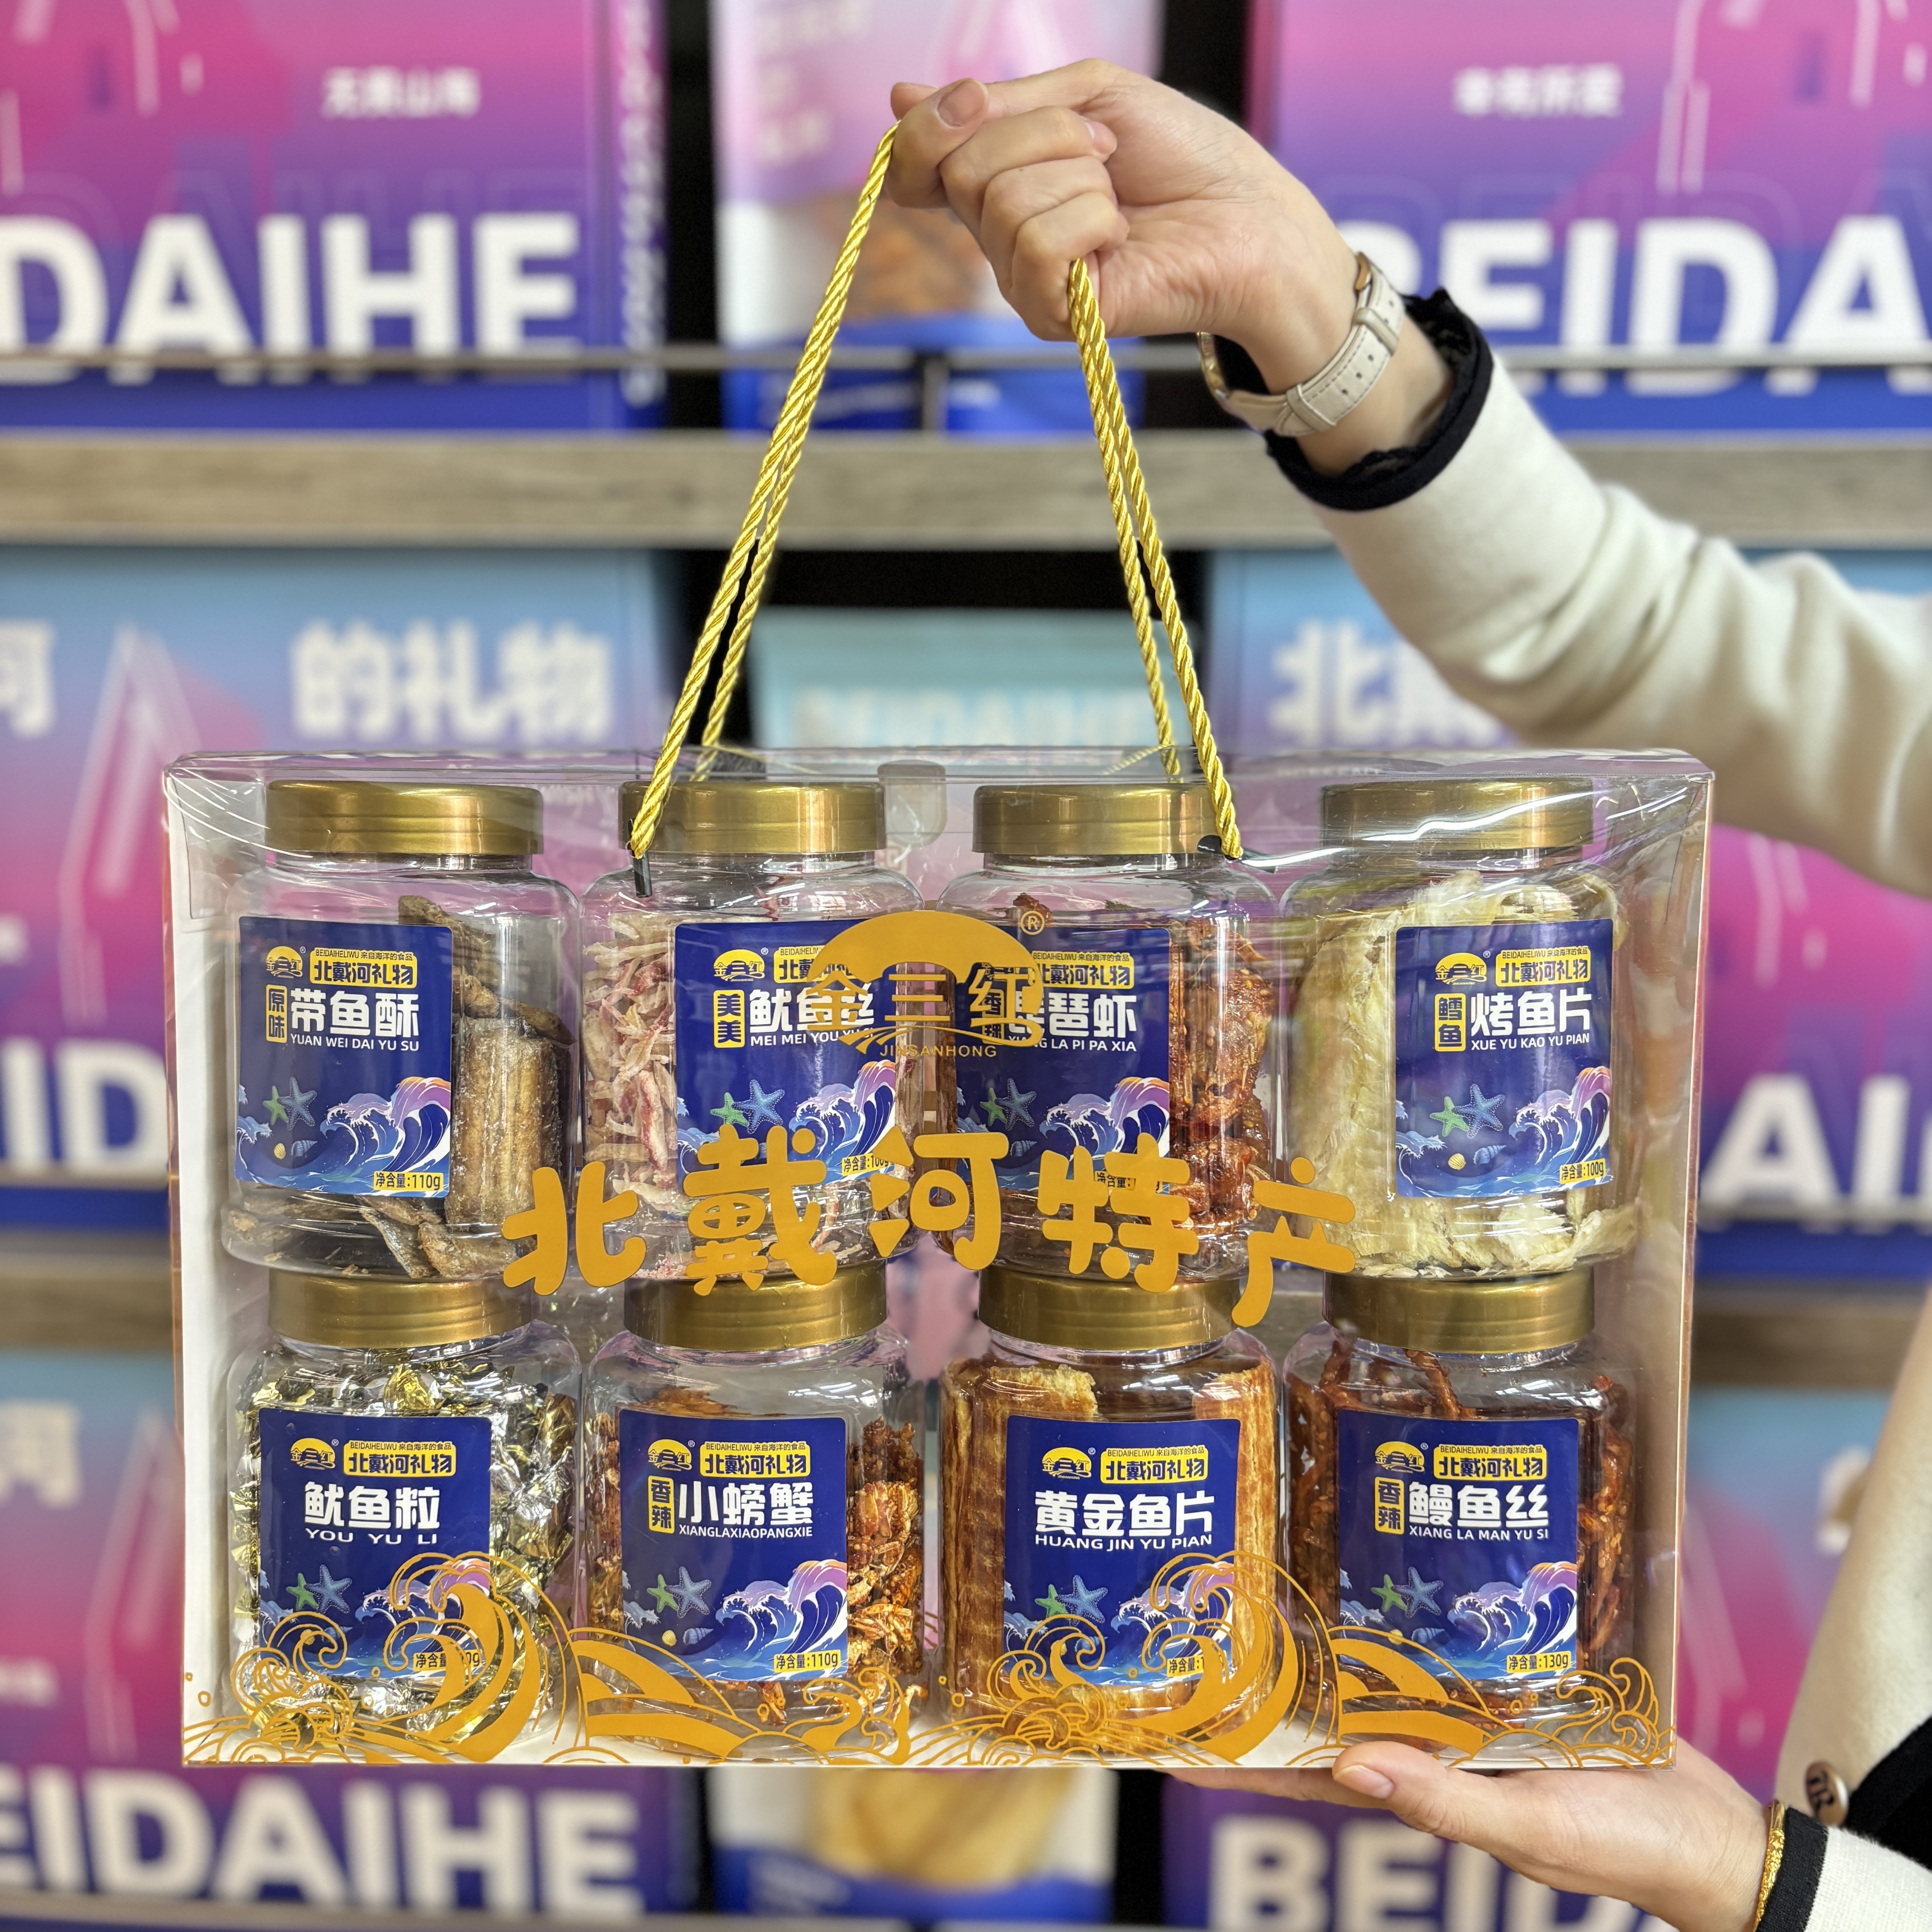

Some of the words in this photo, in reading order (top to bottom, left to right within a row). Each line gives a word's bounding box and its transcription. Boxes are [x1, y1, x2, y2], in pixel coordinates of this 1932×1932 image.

[1033, 952, 1076, 961] BEIDAIHELIWU
[1078, 952, 1129, 961] 来自海洋的食品
[1502, 949, 1546, 959] BEIDAIHELIWU
[314, 960, 414, 985] 北戴河礼物
[1501, 959, 1588, 984] 北戴河礼物
[269, 989, 285, 1039] 原味
[290, 988, 419, 1038] 带鱼酥
[718, 994, 741, 1043] 美美
[1438, 996, 1462, 1048] 鳕鱼
[1471, 988, 1592, 1037] 烤鱼片
[290, 1033, 322, 1047] YUAN
[326, 1036, 348, 1048] WEI
[352, 1038, 374, 1050] DAI
[378, 1040, 396, 1051] YU
[401, 1041, 419, 1052] SU
[750, 1035, 776, 1047] MEI
[782, 1033, 806, 1045] MEI
[810, 1031, 838, 1043] YOU
[1051, 1038, 1068, 1050] LA
[1072, 1040, 1085, 1050] PI
[1089, 1039, 1108, 1051] PA
[1111, 1040, 1137, 1052] XIA
[1471, 1040, 1496, 1051] XUE
[1500, 1039, 1517, 1050] YU
[1521, 1037, 1546, 1049] KAO
[1548, 1035, 1563, 1047] YU
[1566, 1033, 1590, 1045] PIAN
[880, 1045, 997, 1058] JINSANHONG
[1561, 1163, 1605, 1181] 净含量:100g
[376, 1173, 441, 1191] 净含量:110g
[502, 1124, 1355, 1328] 北戴河特产
[350, 1441, 397, 1451] BEIDAIHELIWU
[399, 1443, 452, 1451] 来自海洋的食品
[706, 1443, 752, 1451] BEIDAIHELIWU
[754, 1442, 806, 1451] 来自海洋的食品
[1108, 1449, 1155, 1457] BEIDAIHELIWU
[1156, 1446, 1205, 1456] 来自海洋的食品
[1440, 1445, 1489, 1454] BEIDAIHELIWU
[1490, 1445, 1542, 1454] 来自海洋的食品
[349, 1453, 452, 1474] 北戴河礼物
[704, 1453, 806, 1475] 北戴河礼物
[1106, 1458, 1205, 1481] 北戴河礼物
[1439, 1456, 1543, 1478] 北戴河礼物
[304, 1481, 440, 1530] 鱿鱼粒
[651, 1479, 672, 1529] 香辣
[678, 1481, 814, 1526] 小螃蟹
[1378, 1481, 1400, 1530] 香辣
[1409, 1481, 1549, 1528] 鳗鱼丝
[1035, 1490, 1214, 1537] 黄金鱼片
[305, 1527, 354, 1543] YOU
[368, 1533, 402, 1545] YU
[418, 1533, 437, 1545] LI
[679, 1524, 813, 1539] XIANGLAXIAOPANGXIE
[1409, 1525, 1452, 1539] XIANG
[1457, 1529, 1474, 1540] LA
[1478, 1530, 1510, 1541] MAN
[1514, 1530, 1532, 1541] YU
[1536, 1528, 1549, 1539] SI
[1035, 1534, 1103, 1549] HUANG
[1107, 1538, 1134, 1552] JIN
[1140, 1538, 1165, 1550] YU
[1172, 1534, 1212, 1549] PIAN
[776, 1652, 838, 1670] 净含量:110g
[1509, 1654, 1569, 1670] 净含量:130g
